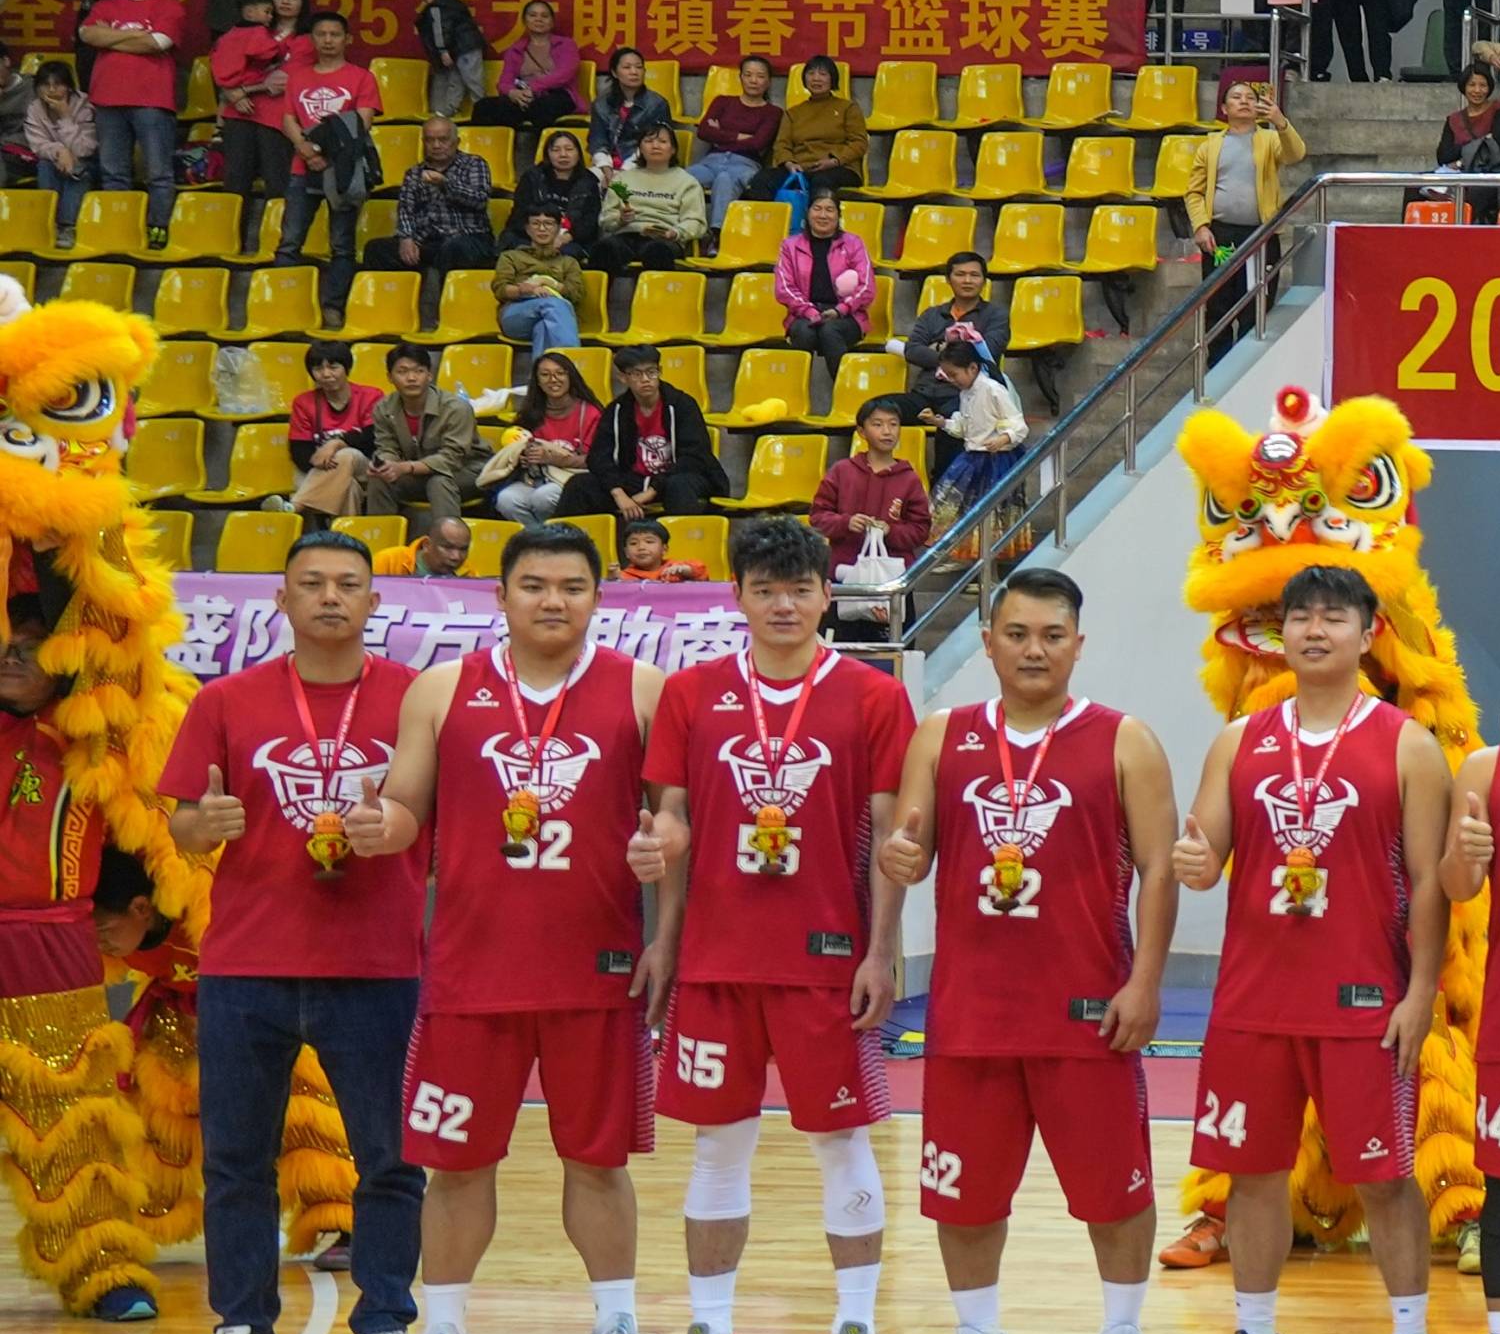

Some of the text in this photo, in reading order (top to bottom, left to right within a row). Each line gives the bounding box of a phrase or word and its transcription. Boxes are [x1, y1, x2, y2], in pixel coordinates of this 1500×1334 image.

[677, 1033, 728, 1089] 55
[408, 1083, 474, 1145] 52
[1197, 1089, 1247, 1149] 24
[923, 1140, 961, 1201] 32
